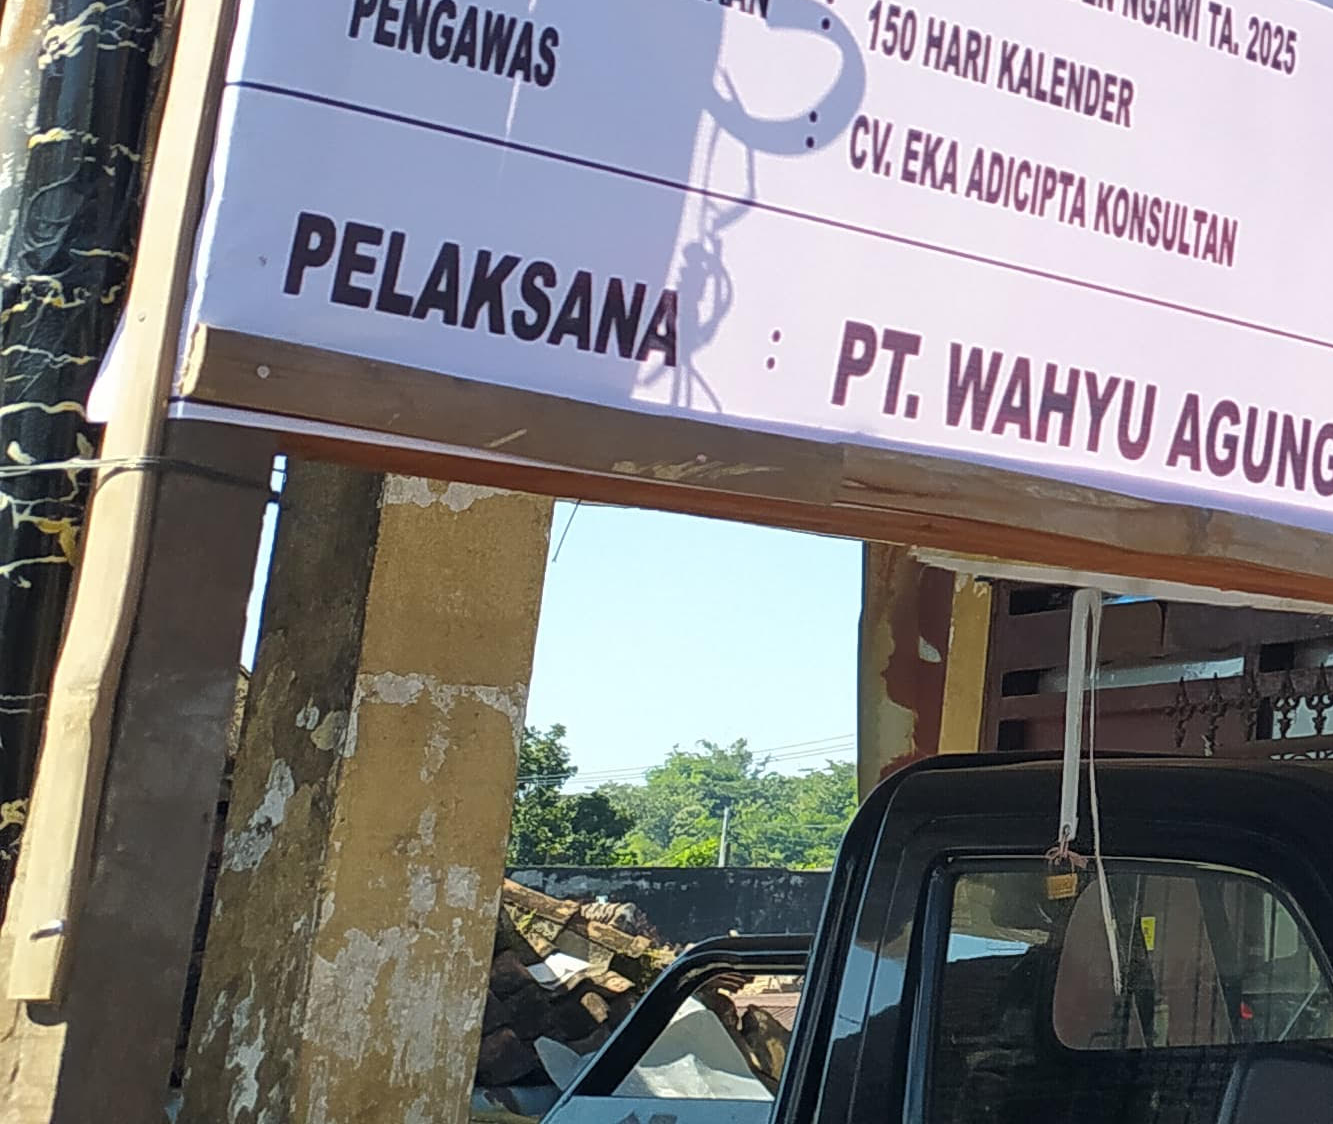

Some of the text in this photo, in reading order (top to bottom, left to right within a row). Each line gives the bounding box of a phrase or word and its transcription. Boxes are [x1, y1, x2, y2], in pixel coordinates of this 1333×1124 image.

[867, 0, 917, 62] 150
[922, 17, 992, 85] HARI
[996, 38, 1135, 128] KALENDER
[1207, 0, 1239, 56] TA.
[1245, 16, 1298, 76] 2025
[849, 114, 893, 178] CV.
[900, 128, 957, 195] EKA
[965, 146, 1087, 229] ADICIPTA
[1094, 181, 1238, 269] KONSULTAN
[283, 210, 679, 368] PELAKSANA
[830, 320, 922, 420] PT.
[943, 341, 1161, 464] WAHYU
